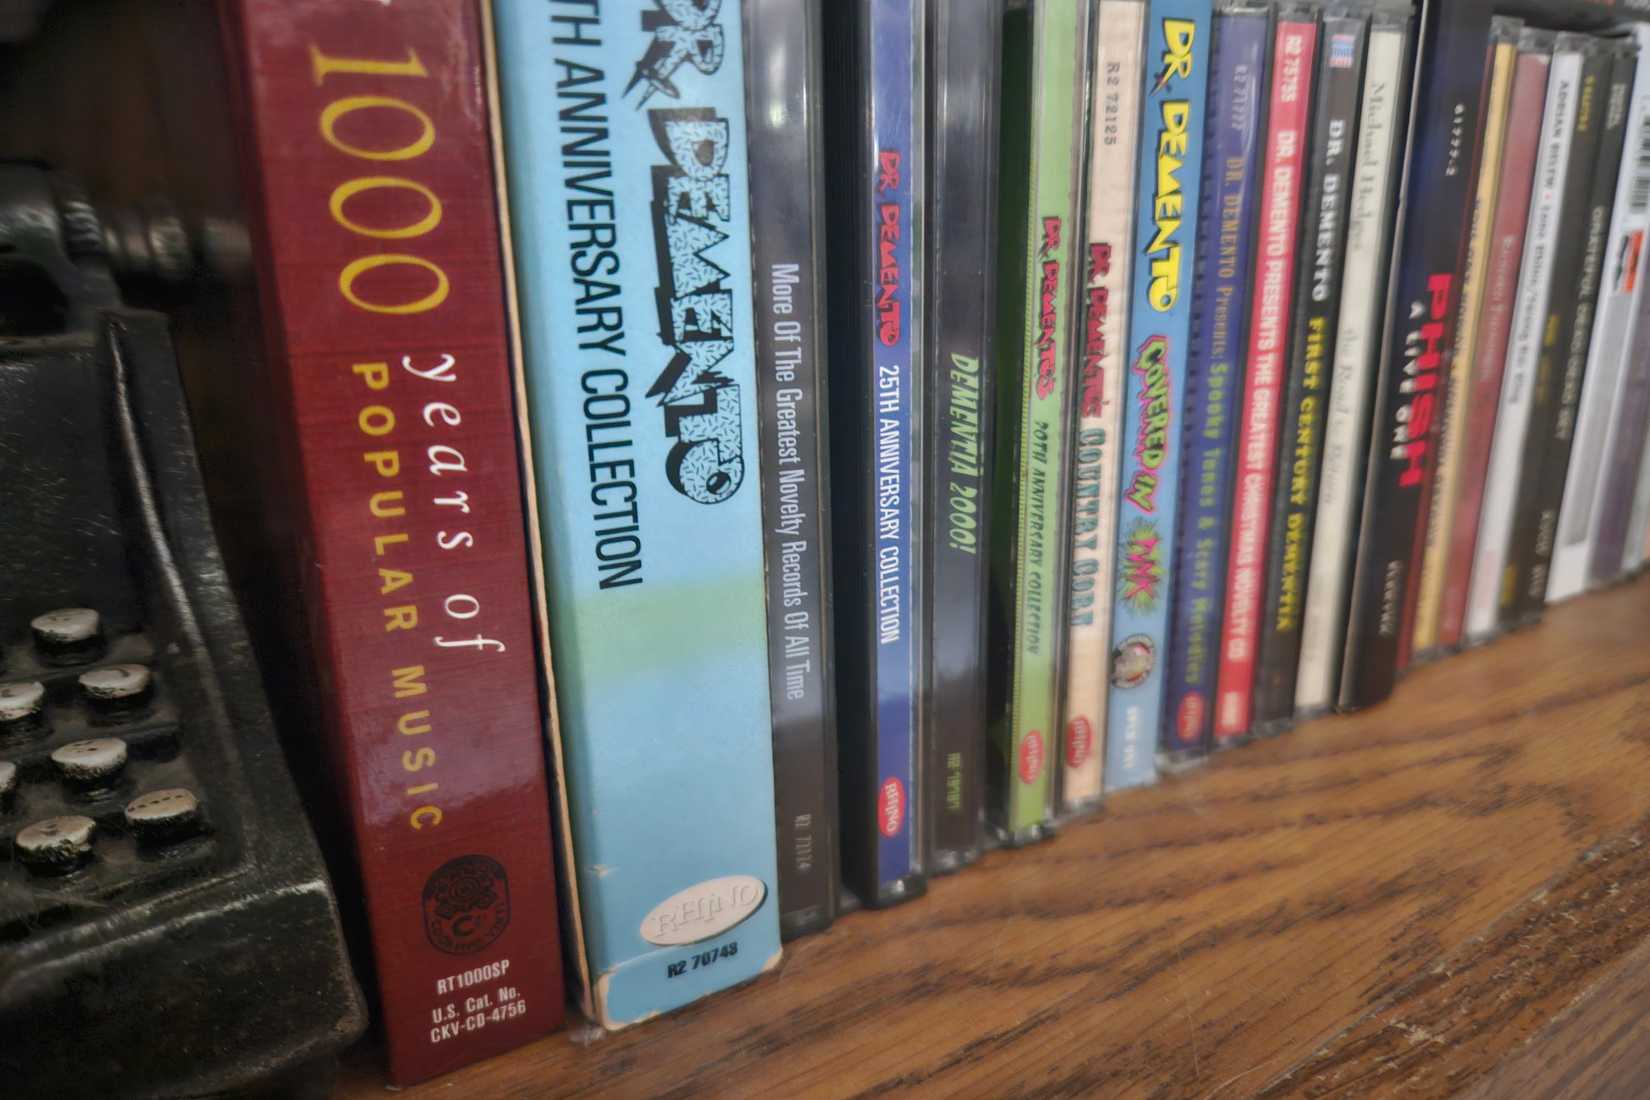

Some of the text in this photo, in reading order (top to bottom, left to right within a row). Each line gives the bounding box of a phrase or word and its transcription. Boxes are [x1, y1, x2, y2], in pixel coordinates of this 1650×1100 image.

[1103, 94, 1119, 146] 72125
[1105, 62, 1121, 87] R2
[1326, 119, 1346, 166] DR.
[553, 58, 628, 356] ANNIVERSARY
[1143, 98, 1191, 313] DEMENTO
[1217, 193, 1242, 279] DEMENTO
[1266, 165, 1294, 257] DEMENTO
[1311, 173, 1340, 302] DEMENTO
[645, 106, 747, 505] DEMENTO
[875, 202, 902, 348] DEMENTO
[1256, 259, 1288, 352] PRESENTS
[310, 46, 505, 652] 1000 years of
[878, 364, 900, 414] 25TH
[1252, 353, 1279, 387] THE
[1303, 316, 1328, 391] FIRST
[1389, 301, 1426, 460] A LIVE ONE
[1397, 272, 1454, 489] PHISH
[1132, 334, 1172, 472] COVERED
[1245, 388, 1276, 471] GREATEST
[1290, 396, 1318, 507] CENTURY
[579, 369, 644, 591] COLLECTION
[772, 264, 812, 701] More Of The Greatest Novelty Records Of All Time
[879, 418, 900, 541] ANNIVERSARY
[947, 353, 983, 556] DEMENTIA 2000!
[1121, 469, 1158, 518] IN
[1027, 467, 1047, 566] ANNIVERSARY
[352, 362, 442, 831] POPULAR MUSIC
[879, 545, 901, 645] COLLECTION
[1024, 570, 1042, 659] COLLECTION
[432, 986, 521, 1024] U.S. Cat. No.
[437, 959, 511, 995] RT1000SP
[667, 960, 688, 979] R2
[430, 1000, 527, 1043] CKV-CD-4756
